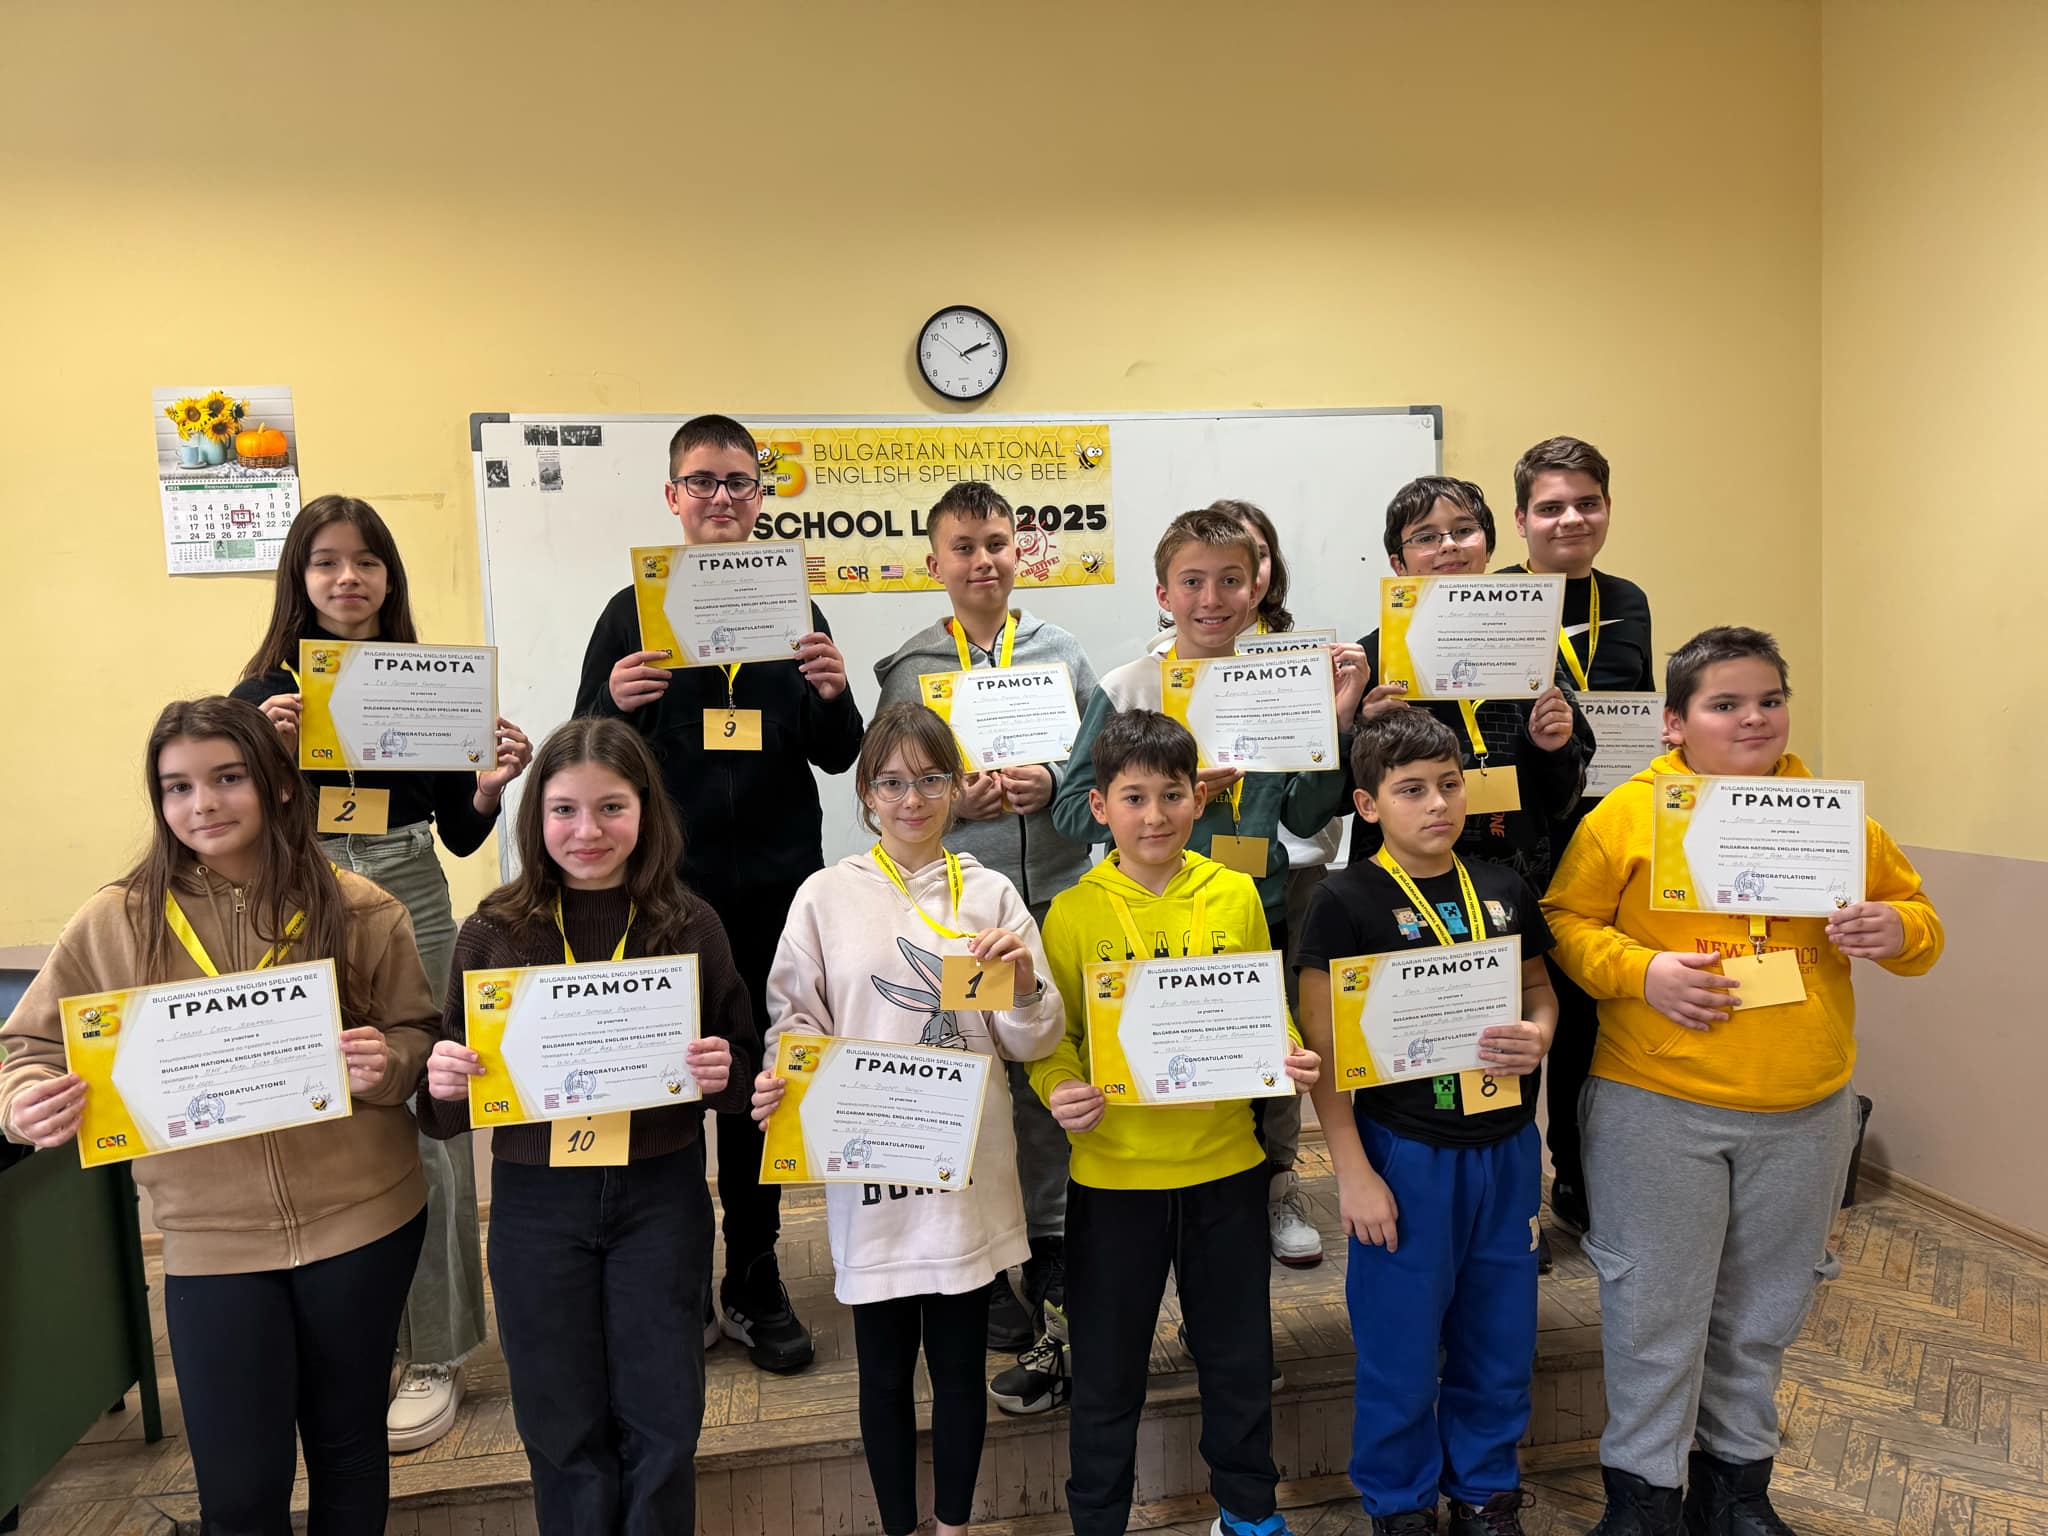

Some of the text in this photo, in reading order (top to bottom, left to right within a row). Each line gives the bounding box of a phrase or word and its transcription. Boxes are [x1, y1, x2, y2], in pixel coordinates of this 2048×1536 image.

[814, 442, 1066, 462] BULGARIAN NATIONAL
[816, 463, 1068, 484] ENGLISH SPELLING BEE
[753, 510, 903, 540] SCHOOL
[1016, 504, 1107, 532] 2025
[698, 555, 786, 570] ГРАМОТА
[1020, 556, 1060, 578] CREATIVE!
[1448, 589, 1543, 601] ГРАМОТА
[374, 658, 474, 672] ГРАМОТА
[1223, 664, 1311, 682] ГРАМОТА
[976, 675, 1053, 690] ГРАМОТА
[1580, 704, 1650, 715] РАМОТА
[723, 722, 736, 737] 9
[334, 800, 356, 821] 2
[1732, 793, 1840, 808] ГРАМОТА
[1402, 955, 1498, 979] ГРАМОТА
[152, 991, 195, 1004] BULGARIAN
[197, 985, 234, 997] NATIONAL
[236, 980, 266, 990] ENGLISH
[268, 975, 302, 985] SPELLING
[539, 975, 576, 984] BULGARIAN
[552, 975, 671, 999] ГРАМОТА
[965, 971, 984, 998] 1
[1158, 970, 1259, 989] ГРАМОТА
[168, 983, 306, 1020] ГРАМОТА
[161, 1063, 199, 1074] BULGARIAN
[200, 1057, 232, 1067] NATIONAL
[234, 1052, 261, 1061] ENGLISH
[263, 1047, 292, 1056] SPELLING
[846, 1049, 880, 1057] BULGARIAN
[882, 1053, 911, 1061] NATIONAL
[1184, 1054, 1243, 1062] CONGRATULATIONS!
[578, 1063, 647, 1076] CONGRATULATIONS!
[854, 1057, 963, 1082] ГРАМОТА
[206, 1079, 286, 1099] CONGRATULATIONS!
[1481, 1074, 1497, 1097] 8
[568, 1130, 595, 1153] 10
